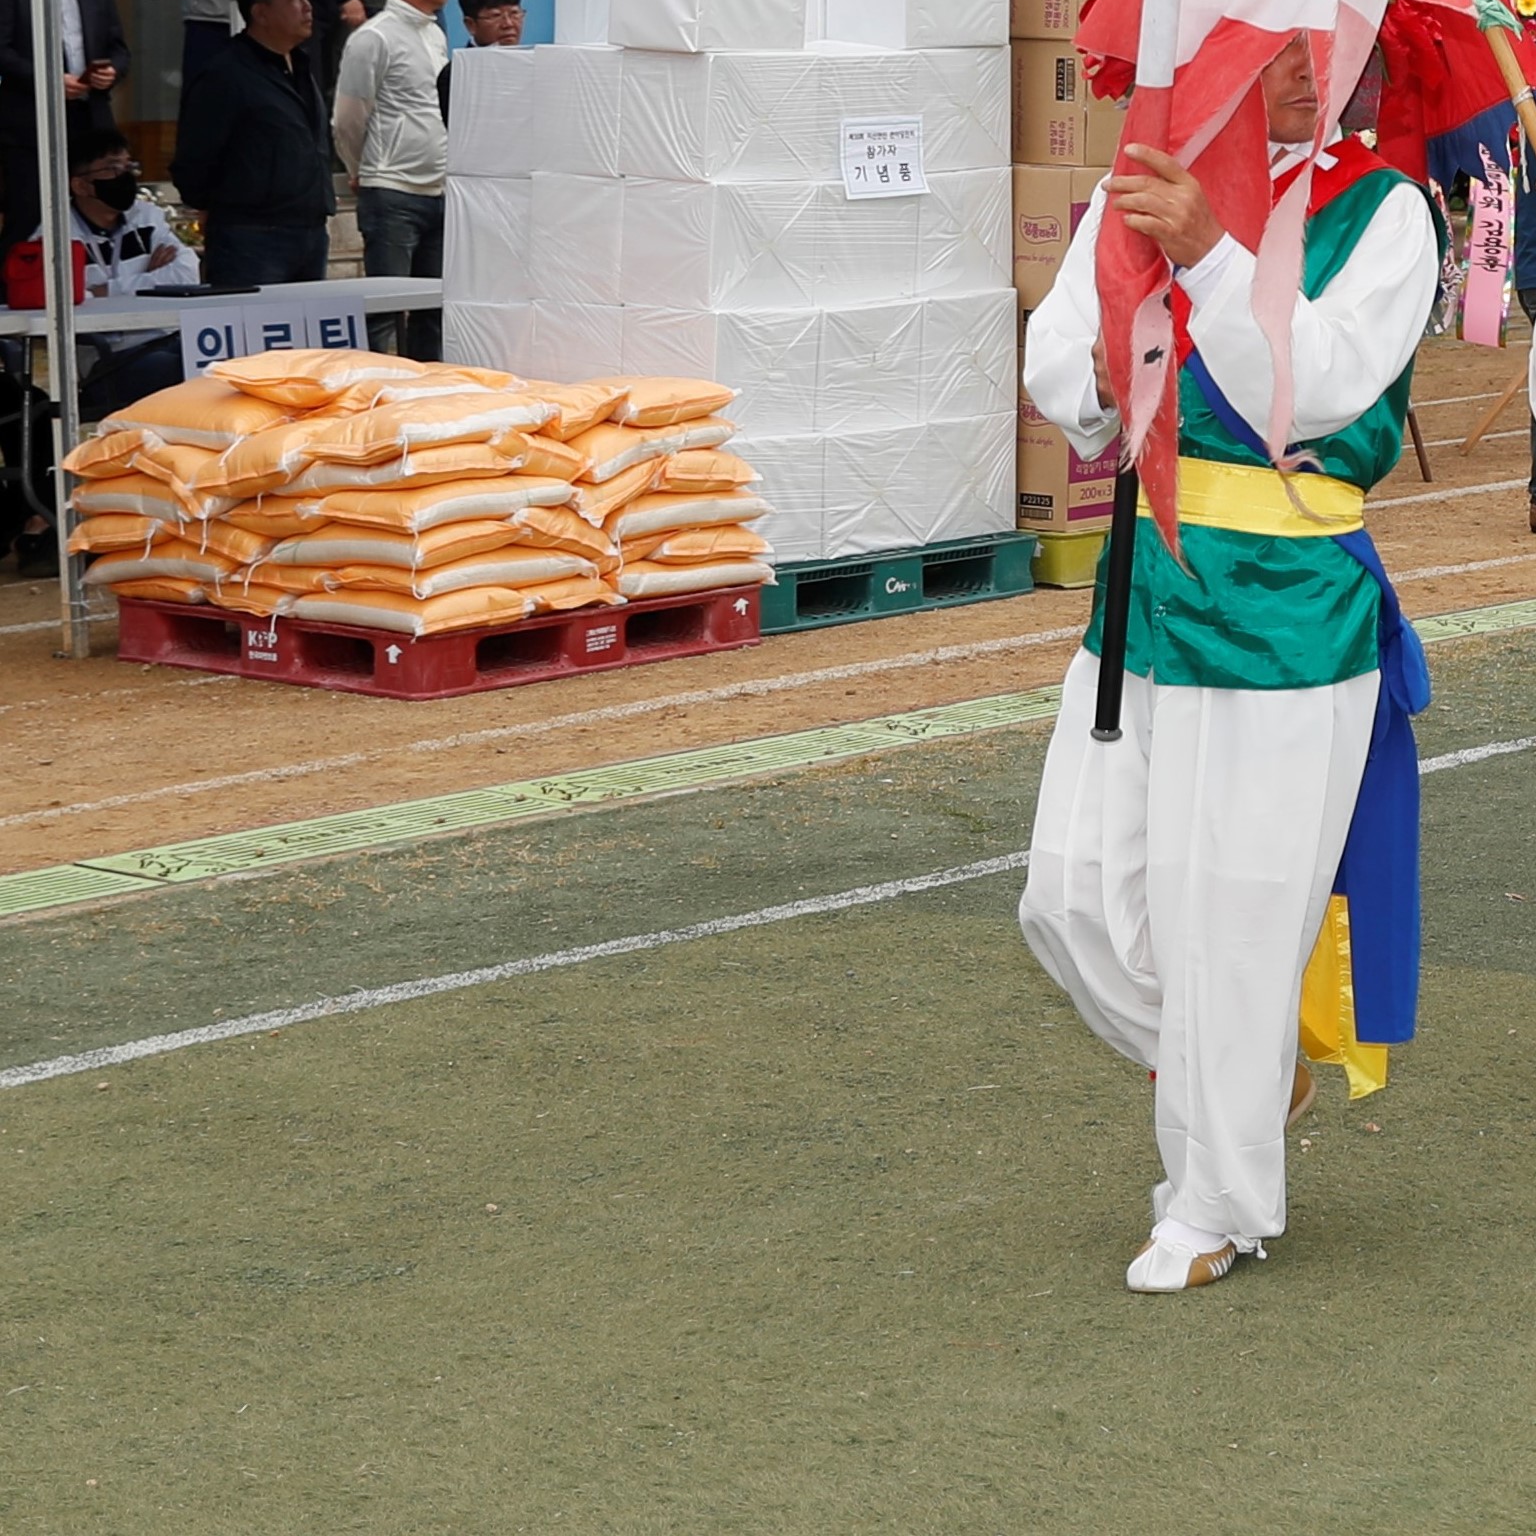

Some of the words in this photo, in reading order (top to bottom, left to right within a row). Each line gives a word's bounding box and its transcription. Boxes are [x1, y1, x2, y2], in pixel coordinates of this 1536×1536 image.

[1057, 60, 1065, 98] P22125
[866, 144, 897, 160] 참가자
[1022, 494, 1051, 506] P22125
